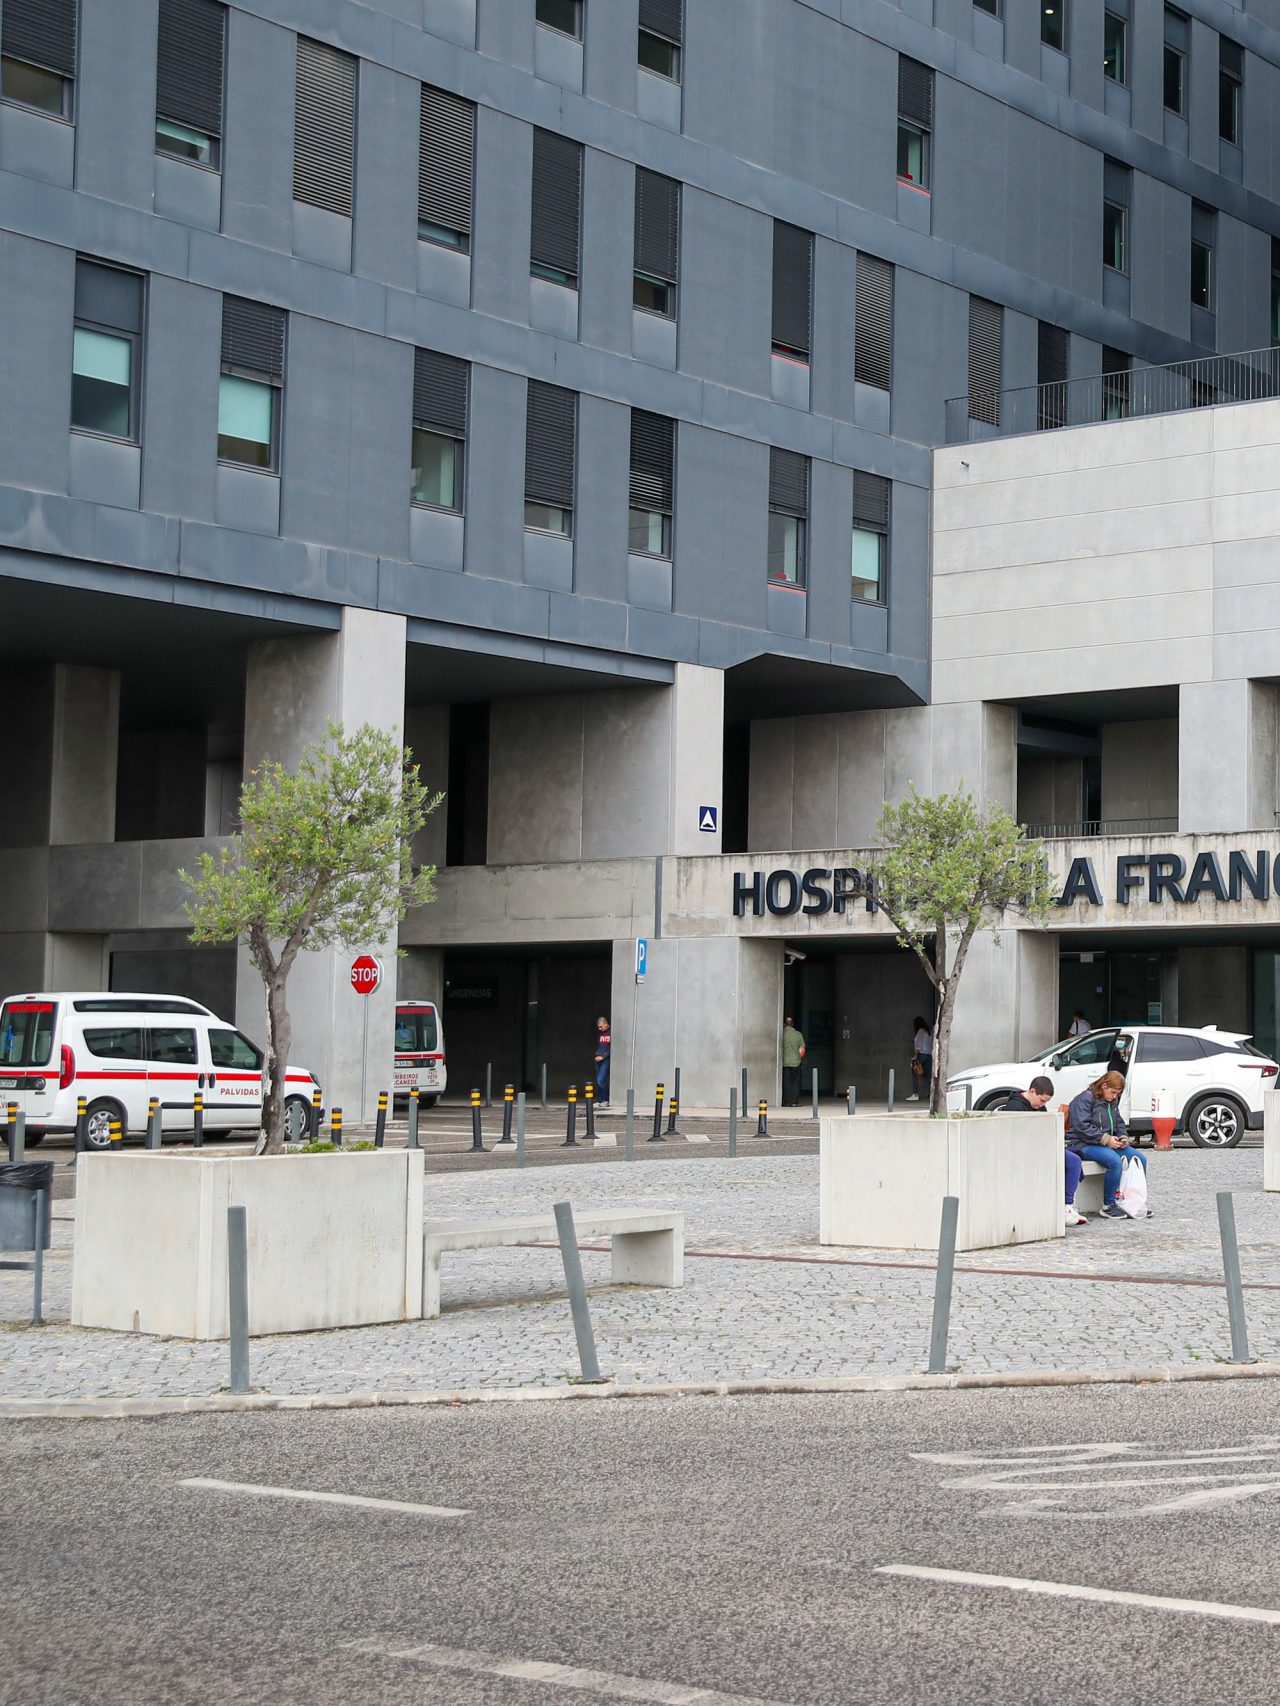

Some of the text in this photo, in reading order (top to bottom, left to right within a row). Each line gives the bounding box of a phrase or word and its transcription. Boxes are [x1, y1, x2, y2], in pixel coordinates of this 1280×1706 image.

[732, 867, 905, 917] HOSPI
[638, 942, 646, 971] P
[351, 967, 378, 982] STOP
[220, 1087, 260, 1096] PALVIDAS
